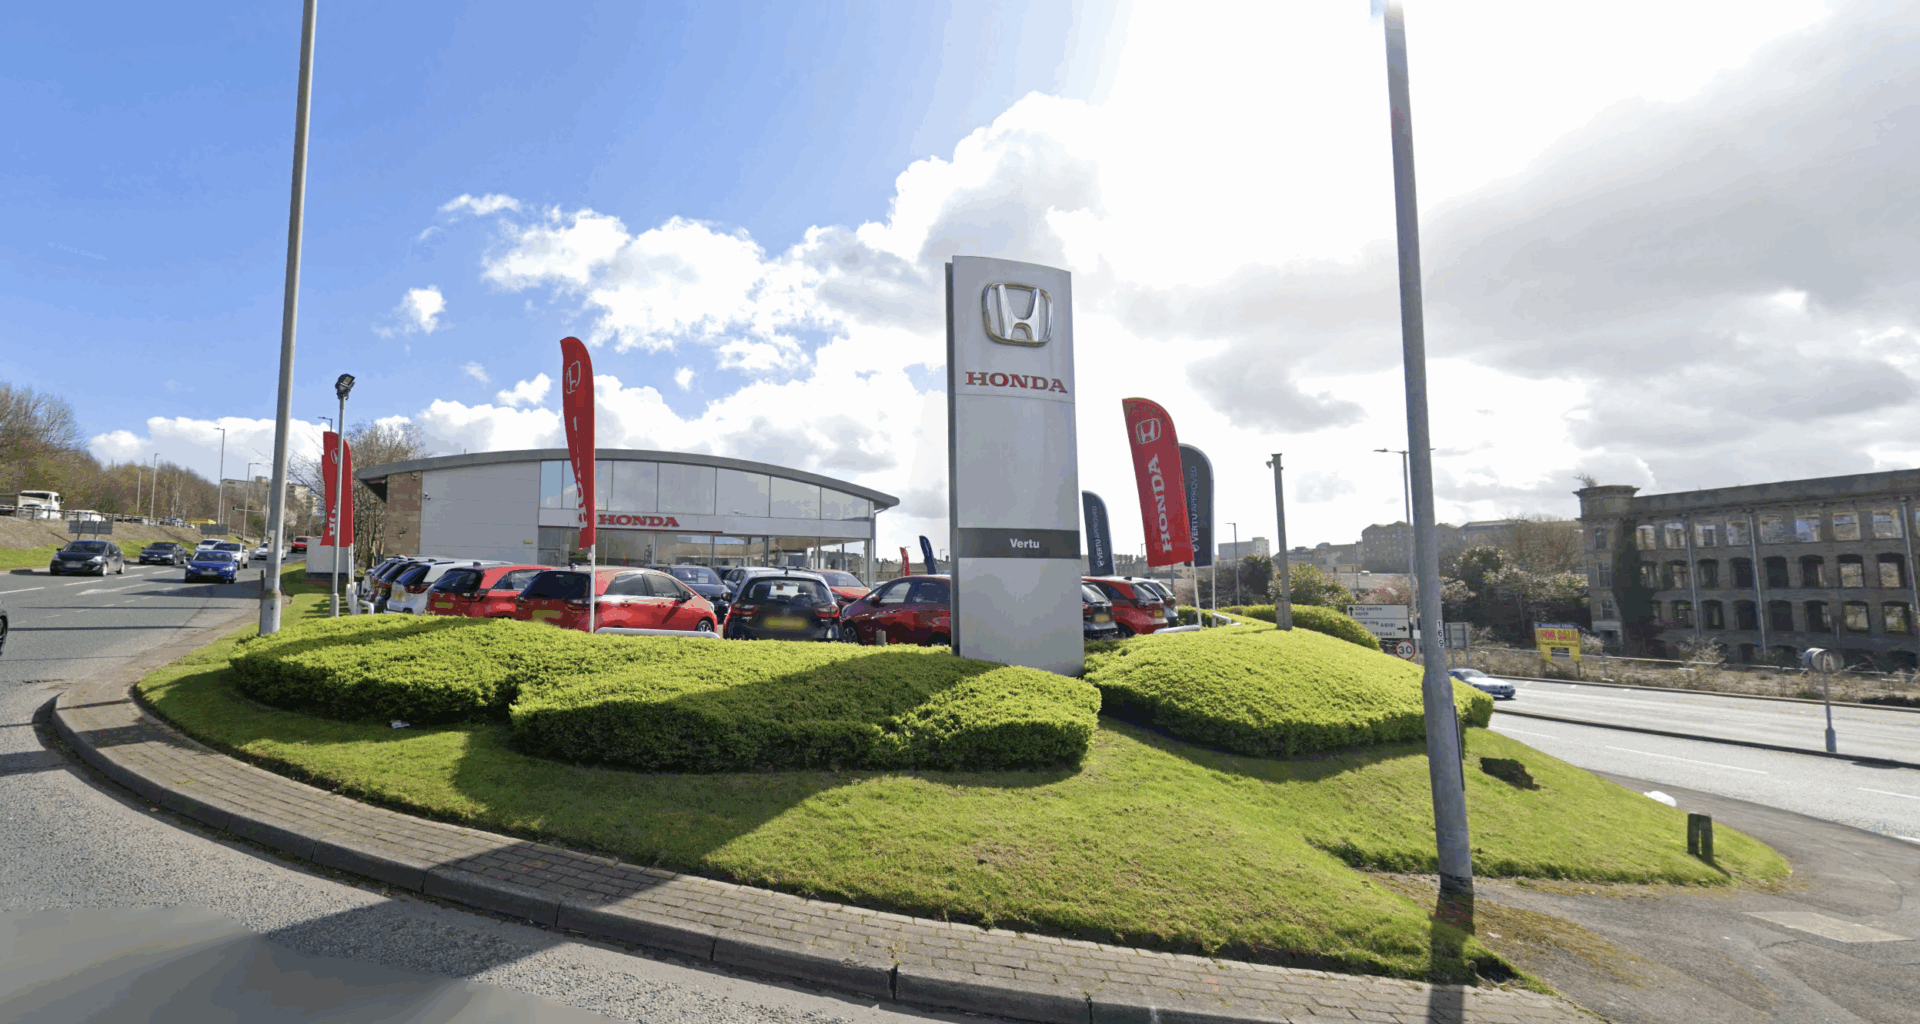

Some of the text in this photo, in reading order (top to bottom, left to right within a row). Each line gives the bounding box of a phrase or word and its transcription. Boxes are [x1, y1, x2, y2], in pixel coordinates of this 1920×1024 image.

[965, 371, 1068, 393] HONDA
[1148, 453, 1173, 554] HONDA
[1189, 465, 1199, 543] VERTU APPROVED
[598, 514, 680, 527] HONDA
[1009, 538, 1040, 549] Vertu
[1540, 629, 1556, 640] FOR
[1398, 645, 1413, 655] 30
